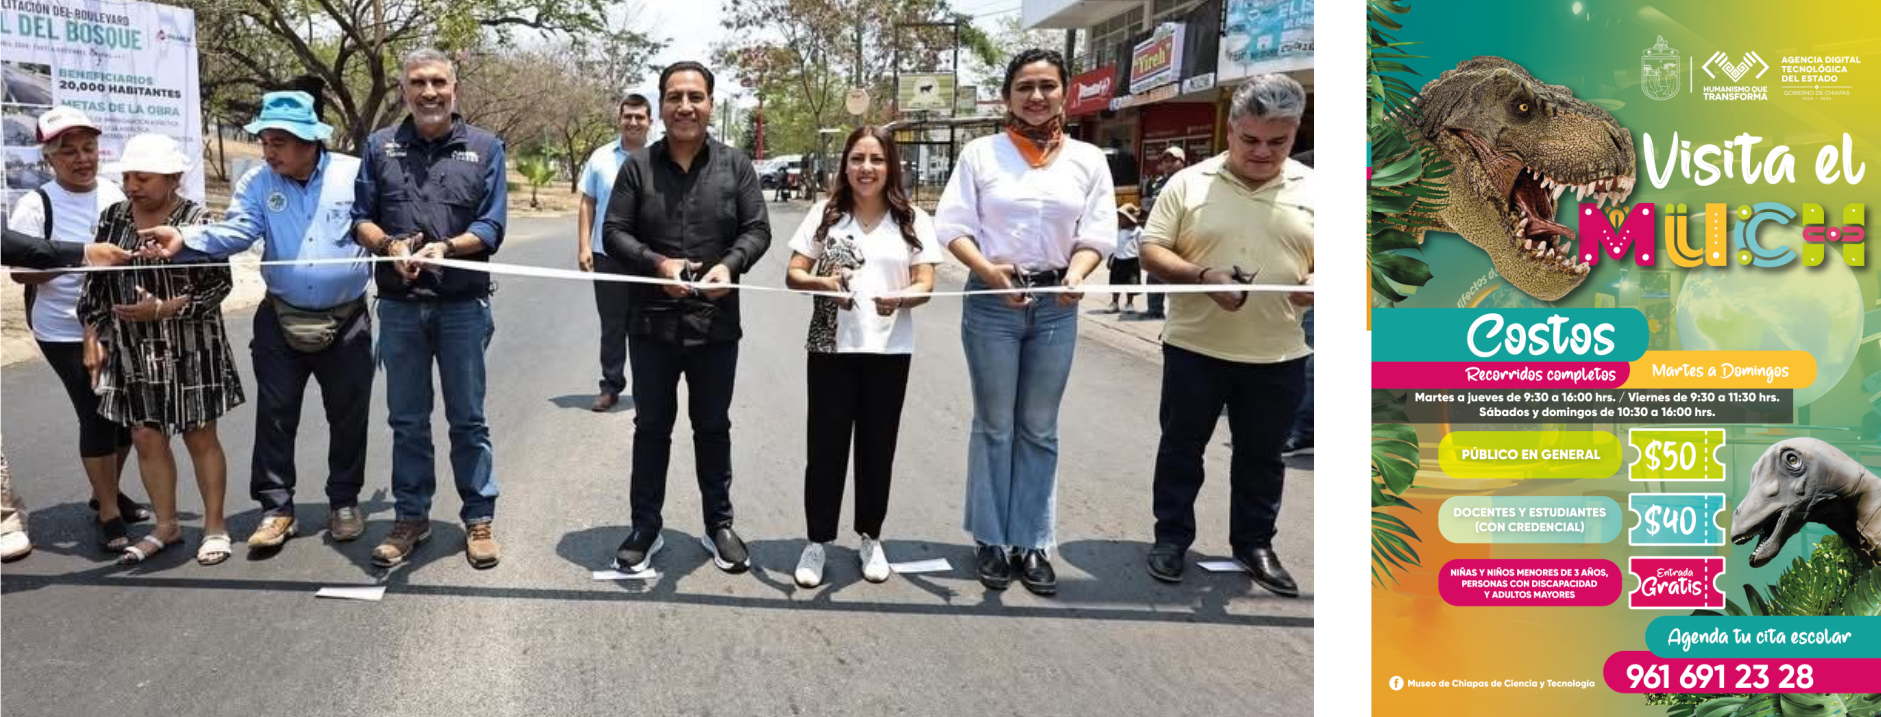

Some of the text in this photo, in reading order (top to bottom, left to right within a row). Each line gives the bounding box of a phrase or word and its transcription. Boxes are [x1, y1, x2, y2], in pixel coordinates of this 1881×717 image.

[53, 6, 71, 18] DEL
[75, 8, 129, 26] BOULEVARD
[18, 13, 60, 40] DEL
[66, 20, 142, 50] BOSQUE
[1781, 56, 1862, 64] AGENCIA DIGITAL
[1781, 64, 1848, 73] TECNOLÓGICA
[59, 69, 154, 86] BENEFICIARIOS
[60, 80, 181, 98] 20,000 HABITANTES
[1703, 86, 1768, 94] HUMANISMO QUE
[1703, 92, 1768, 101] TRANSFORMA
[108, 102, 125, 113] DE
[128, 104, 145, 114] LA
[147, 105, 180, 117] OBRA
[1643, 131, 1866, 189] Visita el
[1467, 313, 1615, 357] Costos
[1465, 366, 1616, 384] Recorridos completos
[1652, 362, 1789, 383] Martes a Domingos
[1415, 391, 1780, 404] Martes a jueves de 9:30 a 16:00 hrs. / Viernes de 9:30 a 11:30 hrs.
[1479, 407, 1715, 419] Sábados y domingos de 10:30 a 16:00 hrs.
[1462, 447, 1600, 460] PÚBLICO EN GENERAL
[1645, 439, 1697, 472] $50
[1453, 508, 1606, 518] DOCENTES Y ESTUDIANTES
[1475, 521, 1584, 533] (CON CREDENCIAL)
[1645, 504, 1697, 537] $40
[1451, 567, 1609, 578] NIÑAS Y NIÑOS MENORES DE 3 AÑOS,
[1656, 568, 1694, 578] Entrada
[1461, 579, 1597, 588] PERSONAS CON DISCAPACIDAD
[1641, 576, 1702, 597] Gratis
[1484, 591, 1575, 599] Y ADULTOS MAYORES
[1667, 627, 1852, 651] Agenda tu cita escolar
[1626, 664, 1814, 688] 961 691 23 28
[1408, 679, 1595, 689] Museo de Chiapas de Ciencia y Tecnología
